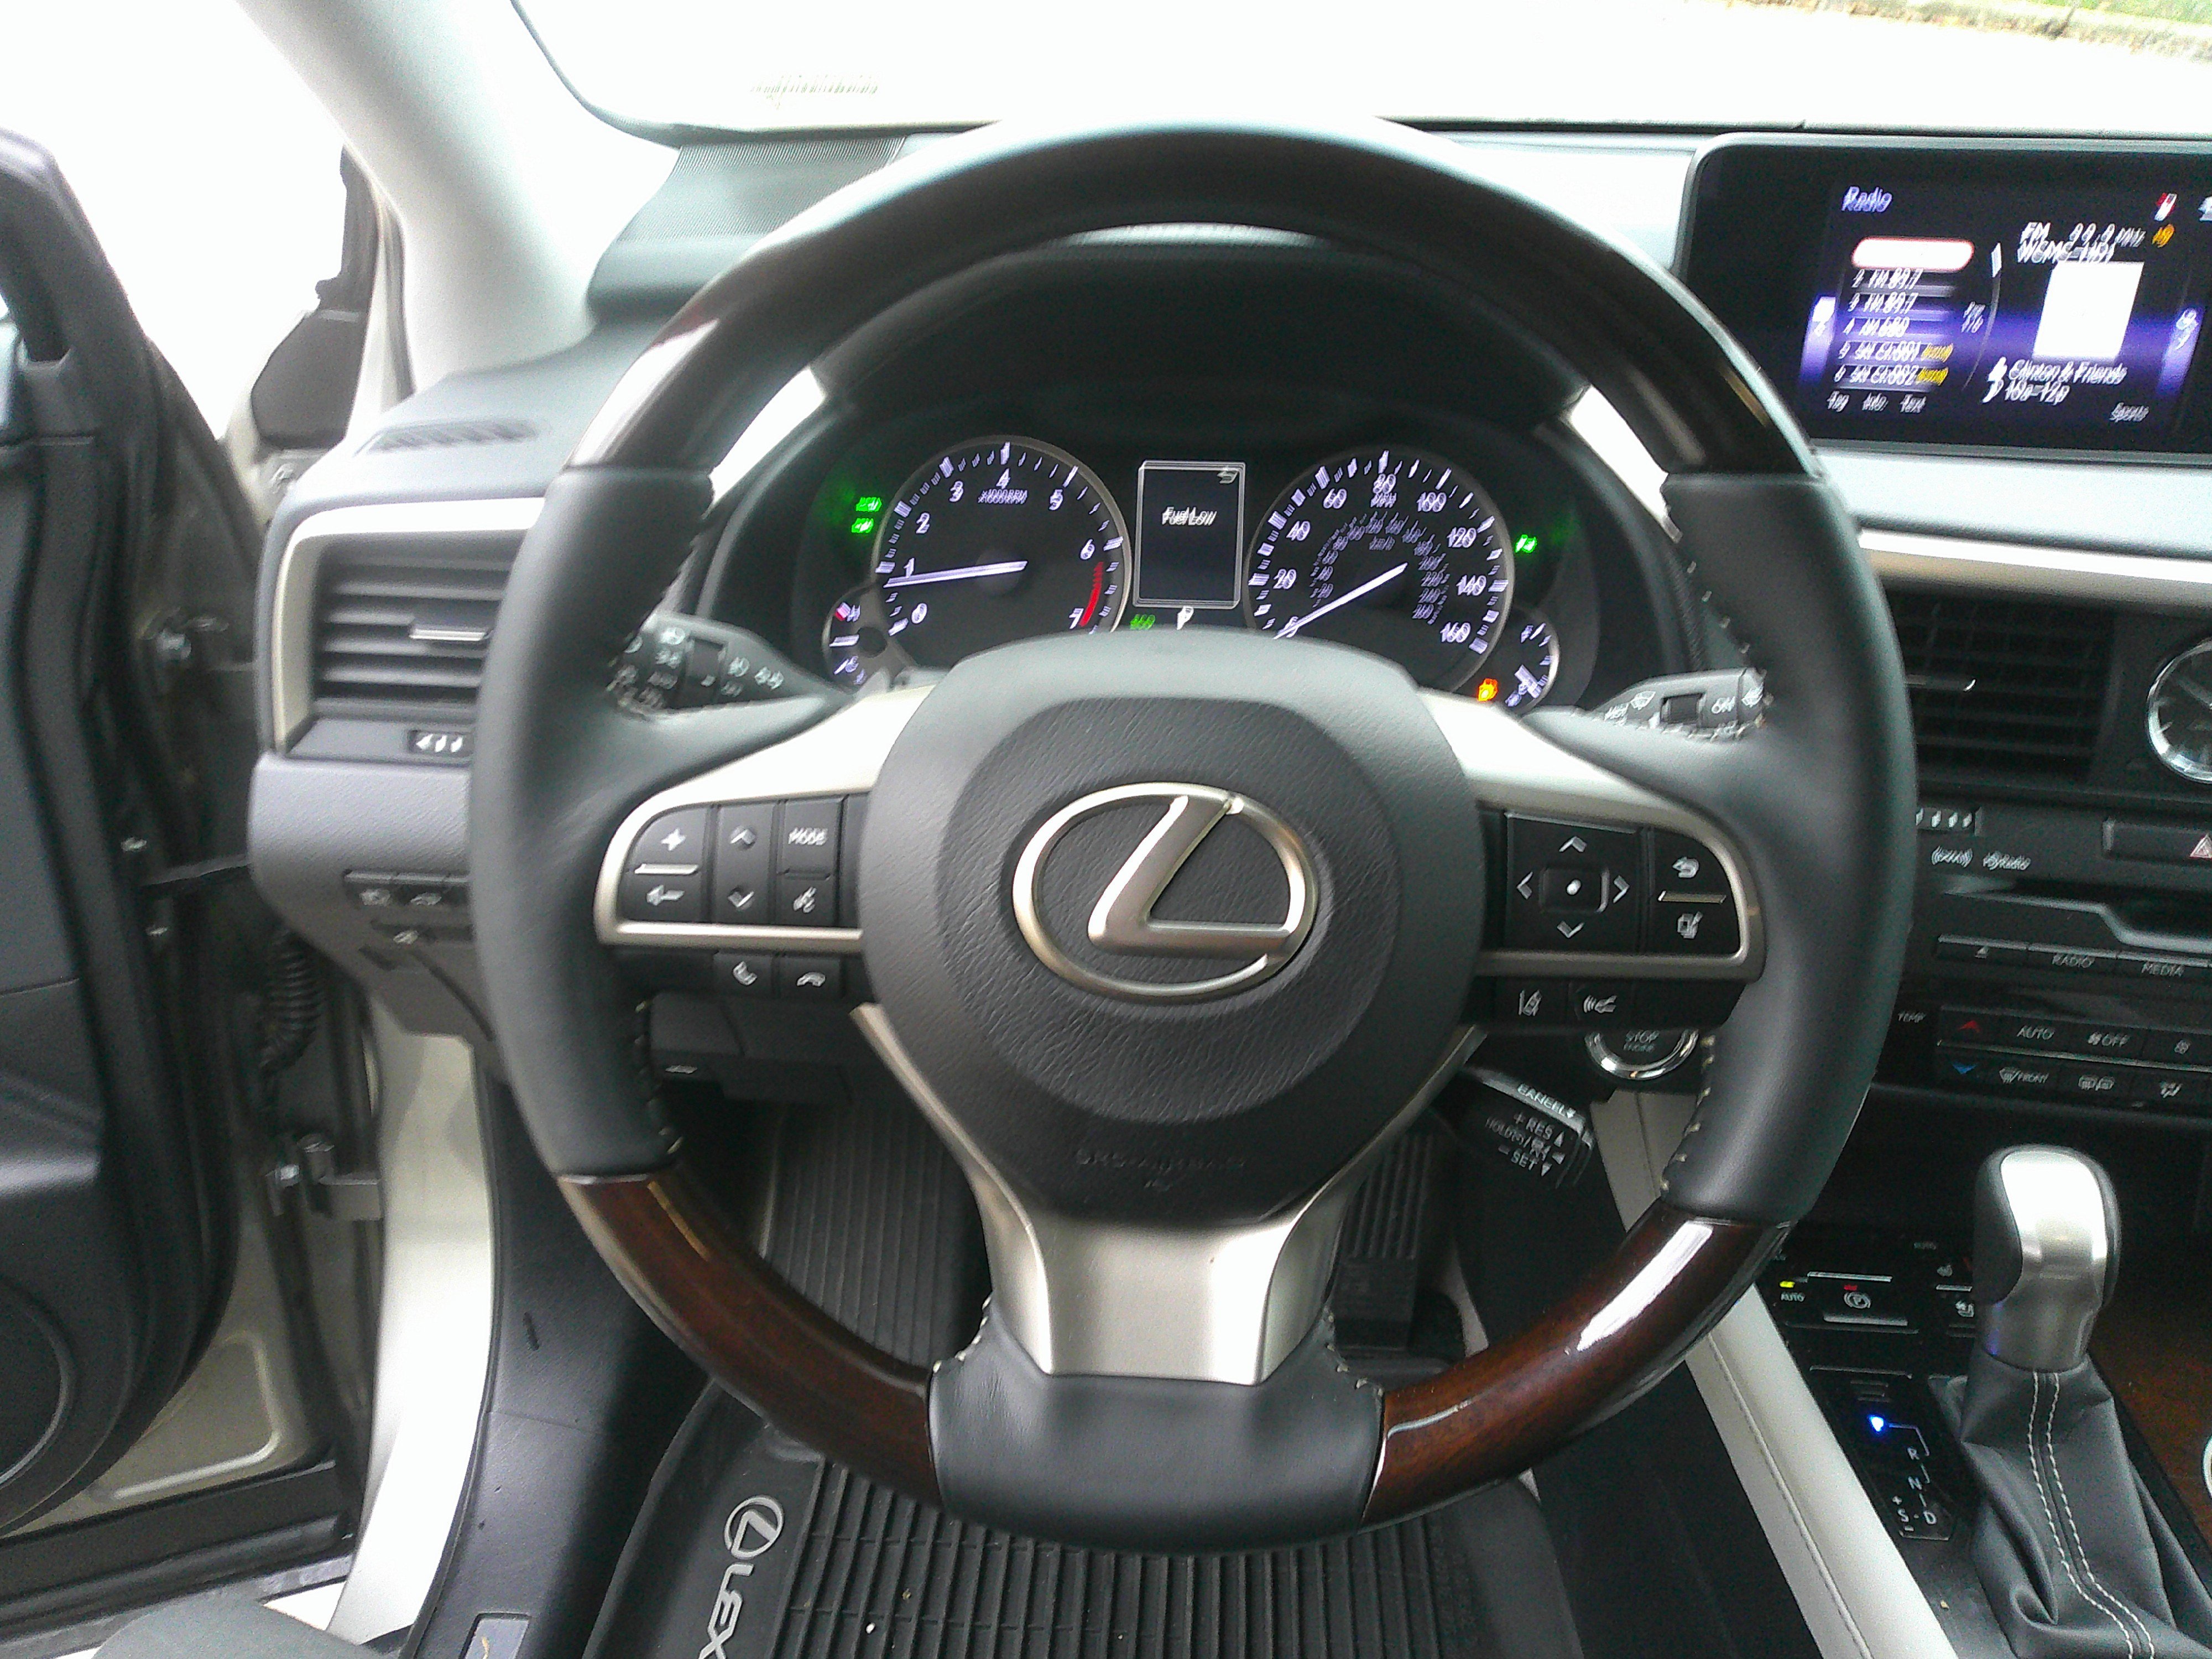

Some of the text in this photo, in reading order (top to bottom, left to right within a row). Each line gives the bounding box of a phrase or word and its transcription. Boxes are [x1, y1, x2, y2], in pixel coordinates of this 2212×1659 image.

[1841, 186, 1893, 212] Radio
[2020, 222, 2051, 243] FM
[2073, 361, 2128, 385] Friends
[996, 468, 1011, 489] 4
[1373, 473, 1397, 494] 80
[950, 481, 964, 502] 3
[1048, 488, 1063, 510] 5
[1323, 488, 1348, 509] 60
[1417, 492, 1447, 513] 100
[916, 512, 930, 534] 2
[1162, 507, 1217, 526] Fuel Low
[1286, 520, 1311, 541] 40
[1447, 527, 1478, 548] 120
[1079, 539, 1095, 560] 6
[903, 557, 915, 578] 1
[1273, 568, 1297, 589] 20
[1456, 575, 1487, 596] 140
[911, 603, 928, 624] 0
[1068, 607, 1084, 629] 7
[1440, 622, 1471, 643] 160
[788, 827, 829, 846] MODE
[2052, 954, 2095, 968] RADIO
[2141, 962, 2185, 977] MEDIA
[1897, 1011, 1927, 1024] TEMP
[2017, 1025, 2055, 1040] AUTO
[2101, 1032, 2130, 1047] OFF
[1517, 1083, 1567, 1117] CANCEL
[1526, 1117, 1555, 1140] RES
[1511, 1147, 1540, 1171] SET
[1780, 1292, 1806, 1303] AUTO
[1907, 1447, 1920, 1460] R
[1908, 1476, 1923, 1490] N
[1897, 1507, 1910, 1522] S
[1923, 1510, 1937, 1525] D
